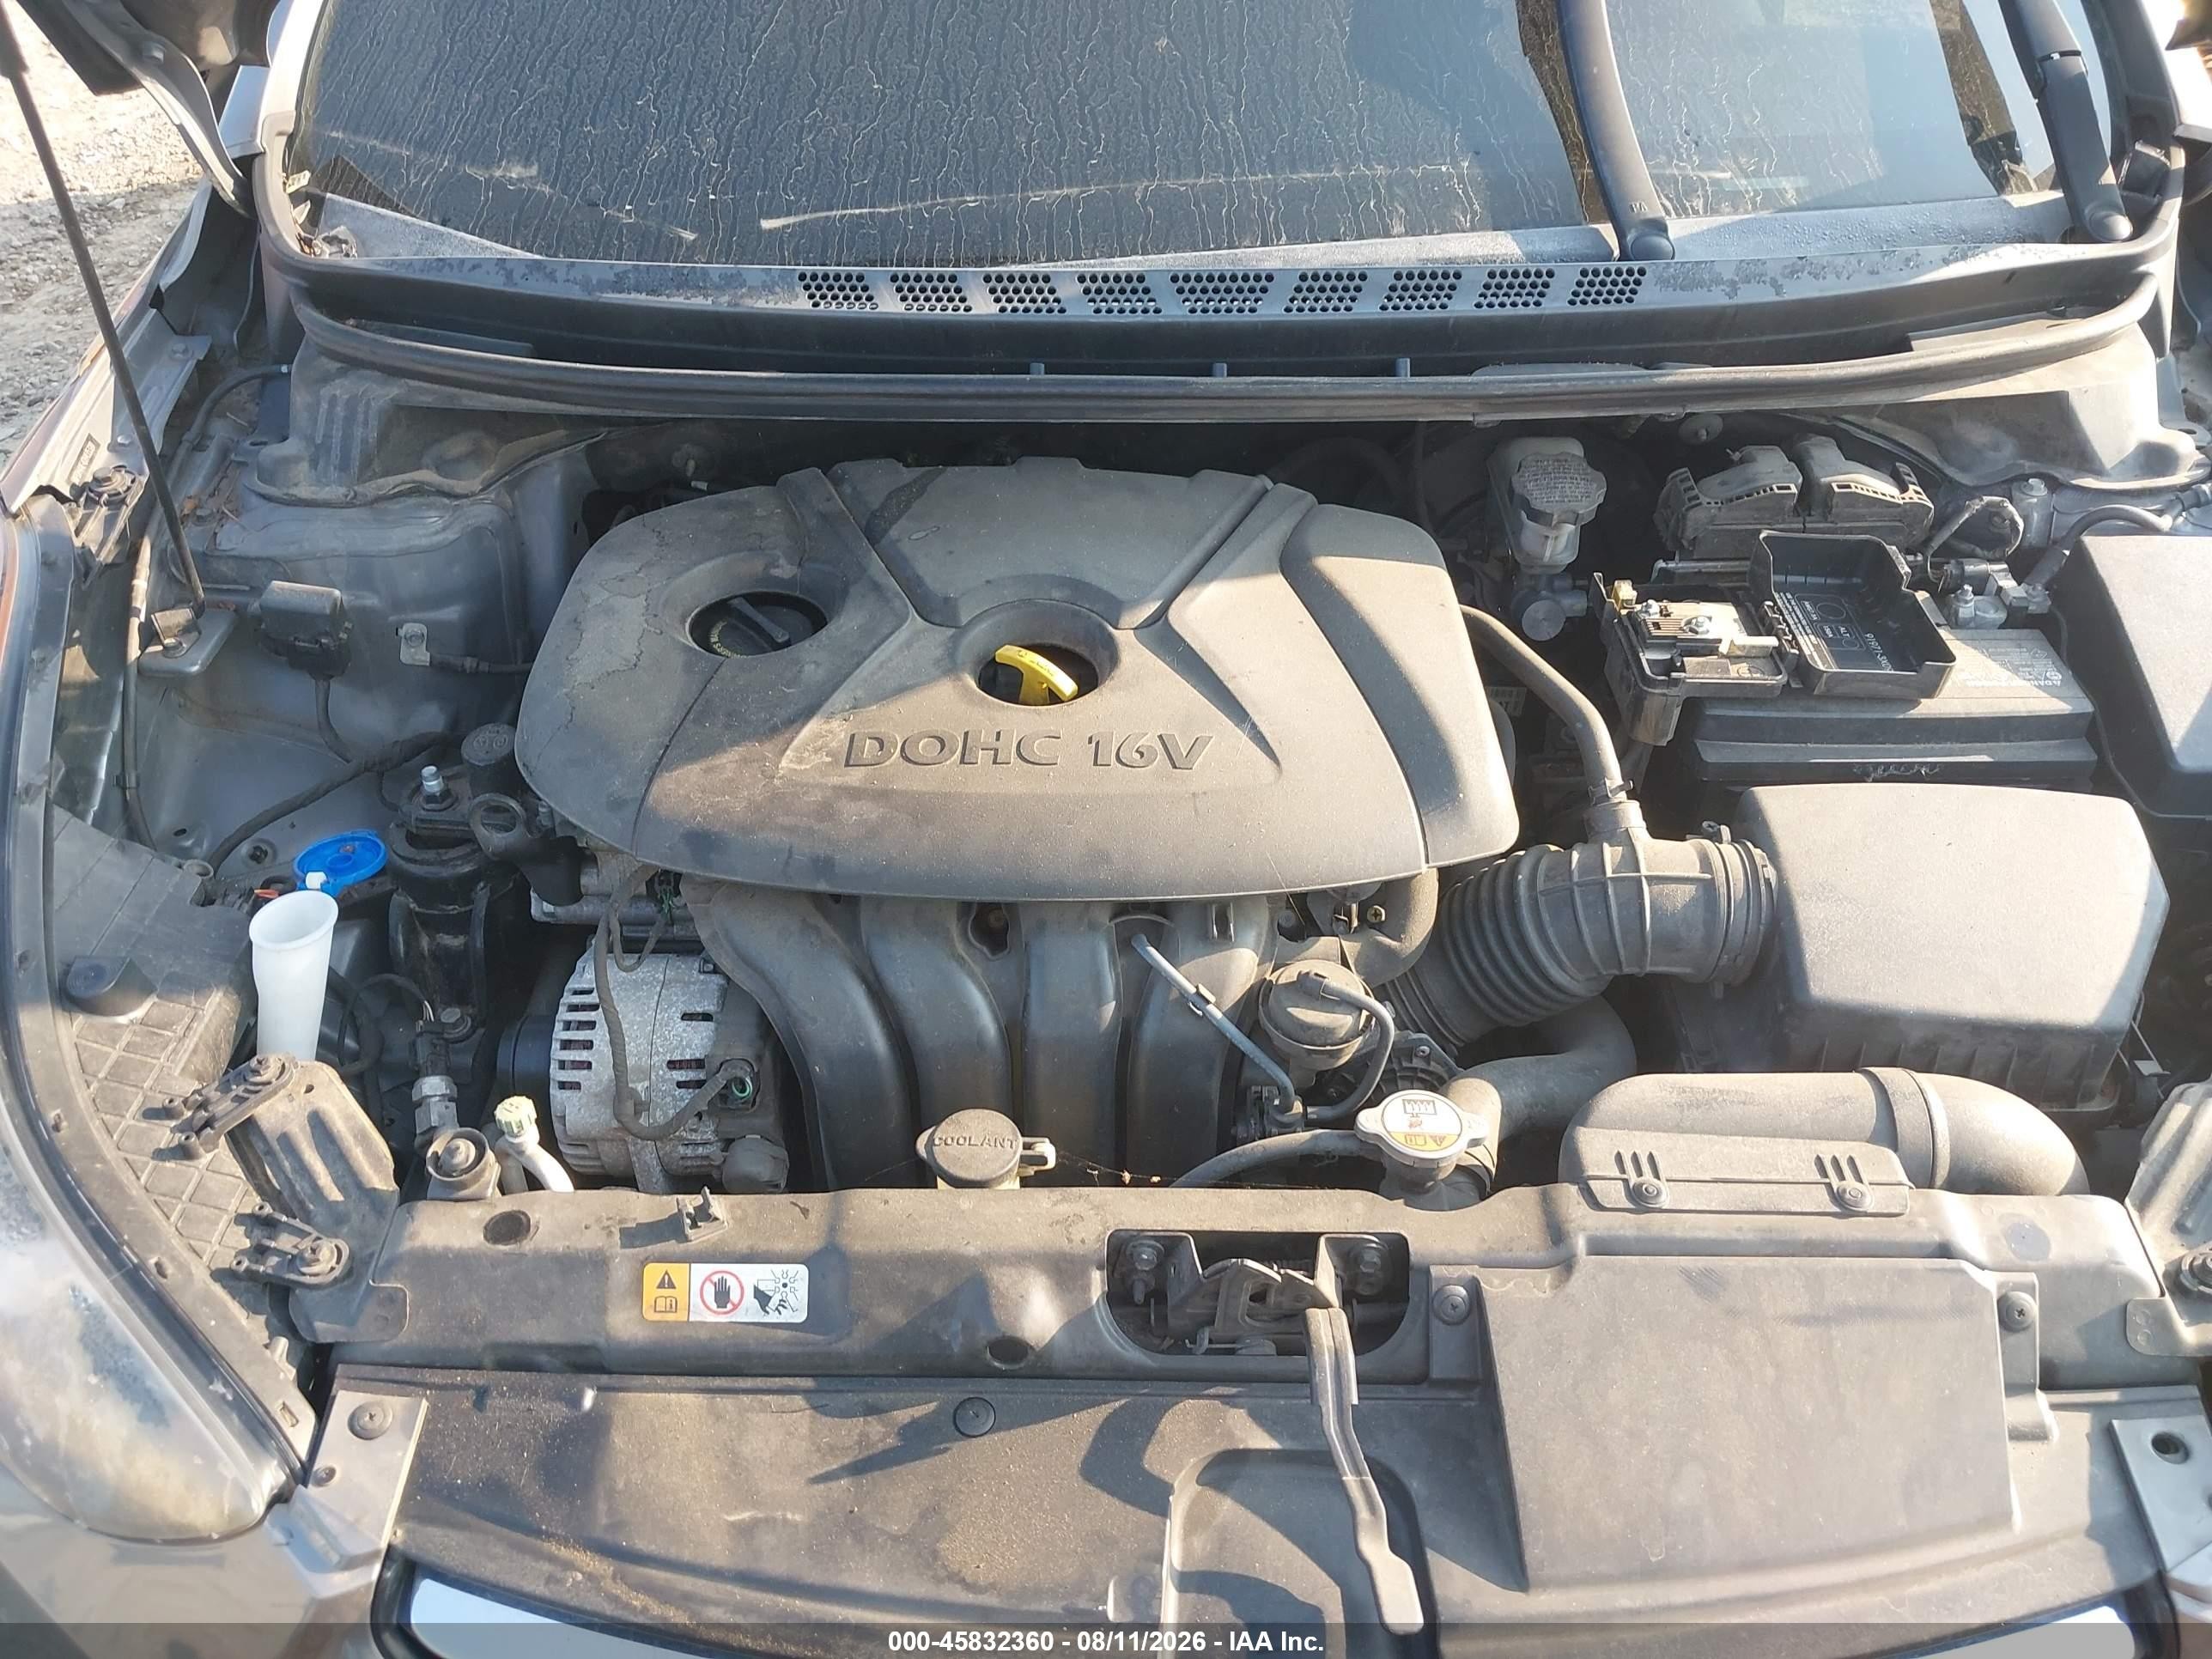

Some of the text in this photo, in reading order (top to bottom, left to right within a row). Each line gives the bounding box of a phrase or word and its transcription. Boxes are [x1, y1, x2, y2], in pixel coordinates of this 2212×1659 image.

[1838, 626, 1850, 639] ALT
[843, 727, 1215, 771] DOHC 16V
[933, 1133, 1018, 1151] COOLANT
